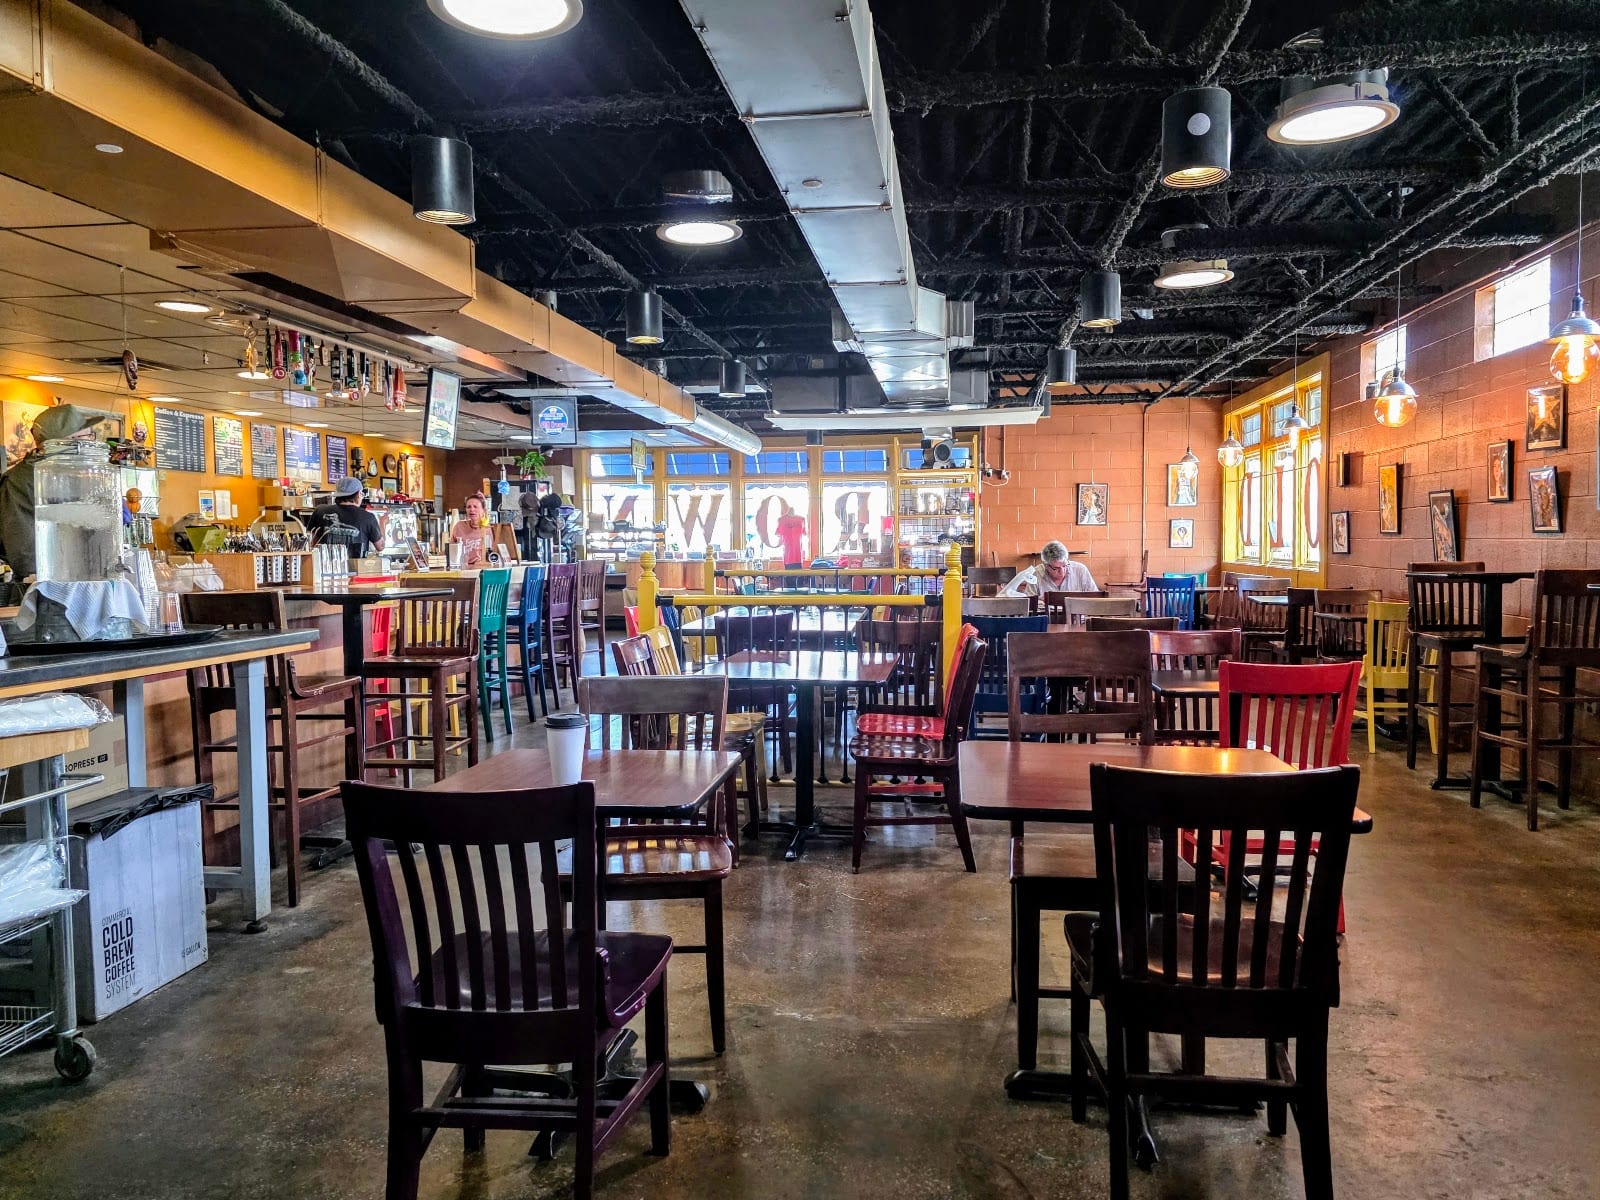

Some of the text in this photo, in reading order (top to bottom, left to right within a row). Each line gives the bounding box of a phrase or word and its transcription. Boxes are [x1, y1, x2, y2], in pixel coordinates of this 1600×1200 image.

[102, 917, 133, 948] COLD
[104, 937, 134, 968] BREW
[105, 956, 135, 984] COFFEE
[106, 972, 136, 999] SYSTEM
